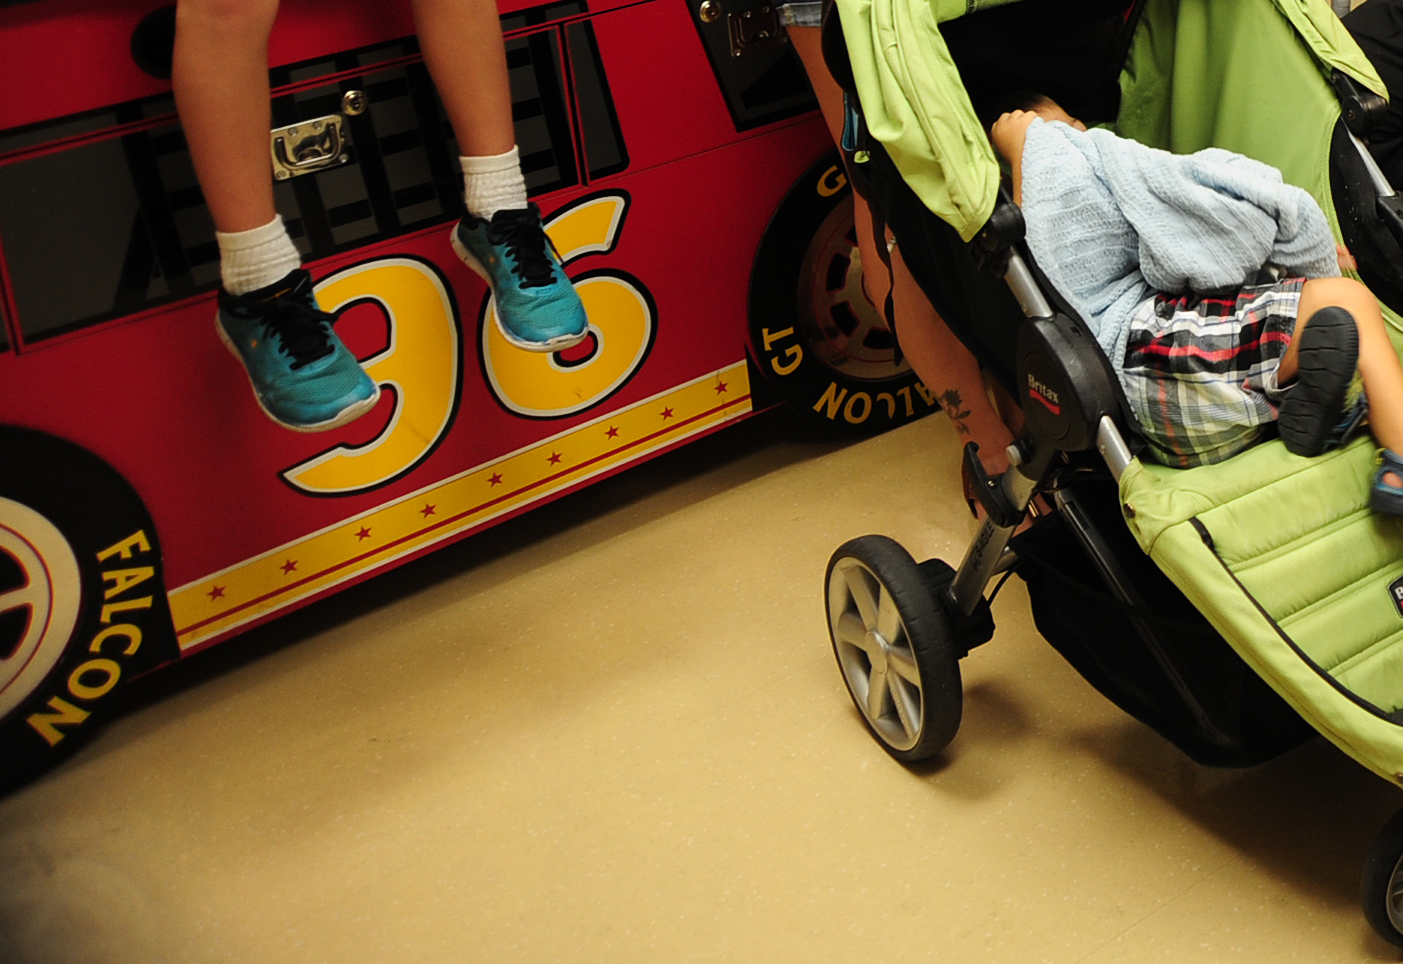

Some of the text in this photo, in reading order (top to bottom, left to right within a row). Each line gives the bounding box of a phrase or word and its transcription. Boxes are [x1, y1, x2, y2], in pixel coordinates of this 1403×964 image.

[276, 188, 658, 498] 96
[762, 326, 803, 376] GT
[812, 381, 936, 424] ALCON
[1028, 373, 1059, 404] Britax
[26, 529, 154, 746] FALCON
